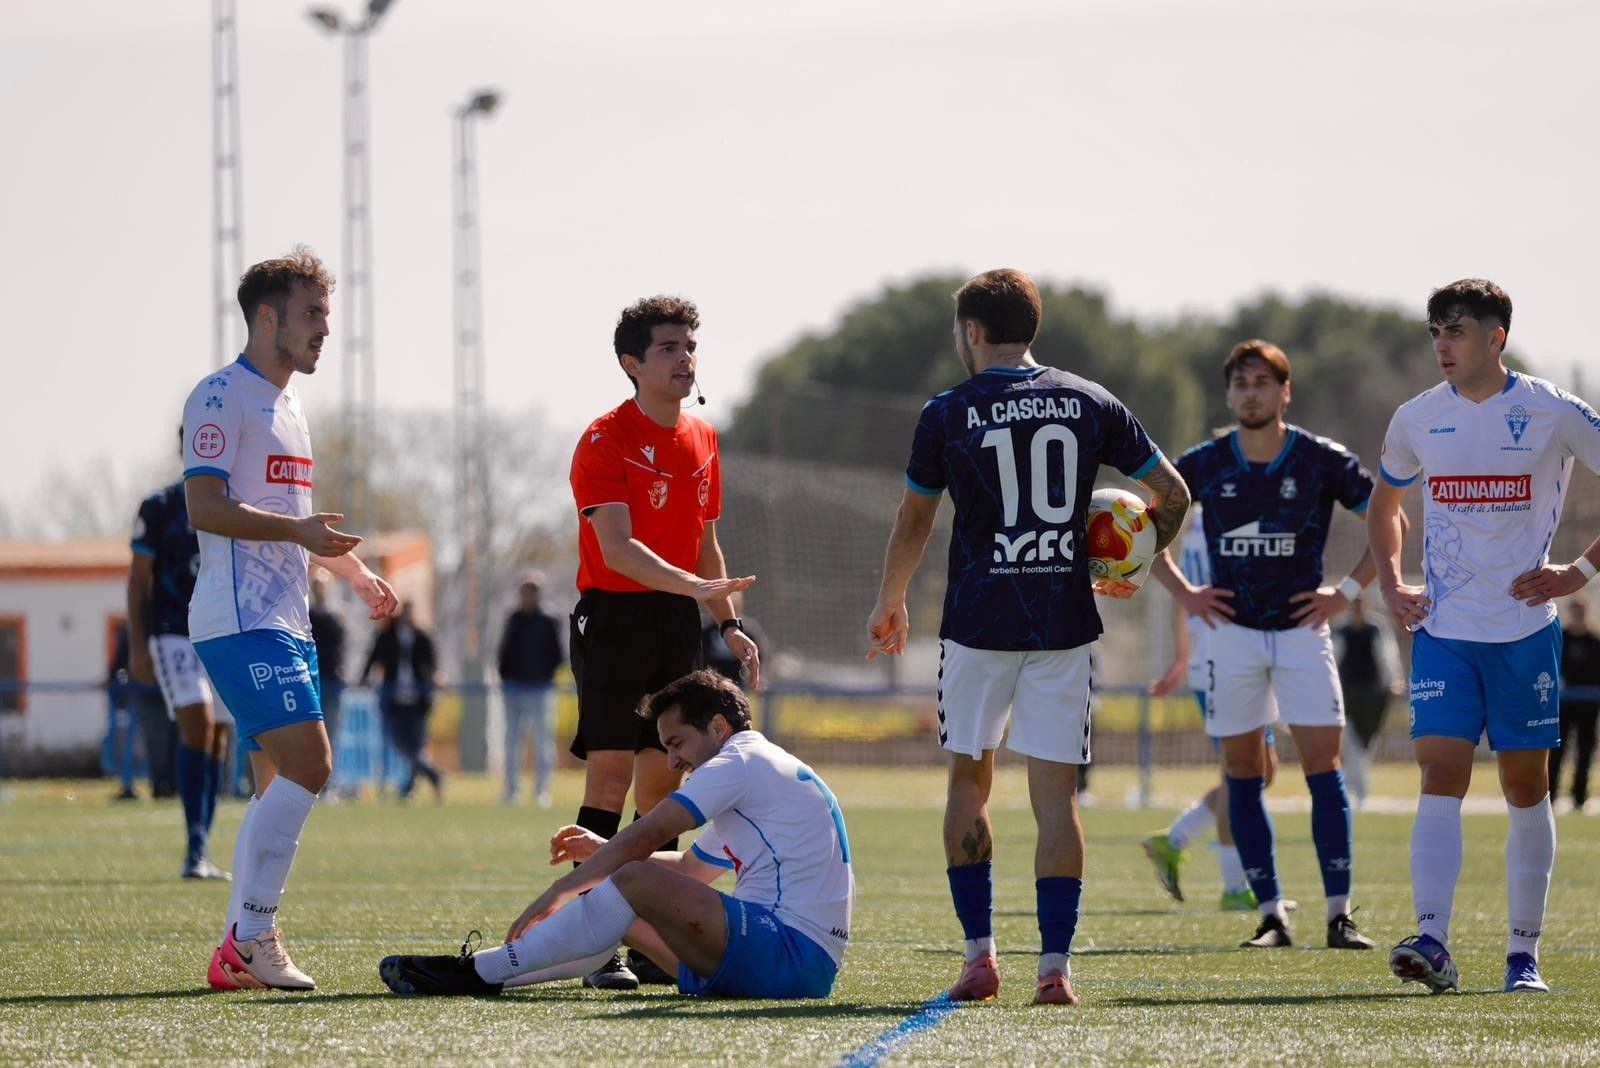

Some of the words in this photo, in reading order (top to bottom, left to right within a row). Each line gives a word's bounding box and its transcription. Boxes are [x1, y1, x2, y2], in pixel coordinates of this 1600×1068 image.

[967, 406, 987, 429] A.
[991, 397, 1081, 423] CASCAJO
[980, 424, 1079, 527] 10
[1431, 477, 1527, 500] CATUNAMBÚ
[1457, 501, 1475, 515] café
[1476, 503, 1485, 512] de
[1486, 502, 1532, 513] Andalucía
[1219, 538, 1295, 556] LOTUS
[1022, 565, 1053, 574] Football
[283, 690, 298, 712] 6
[1410, 690, 1443, 701] magen
